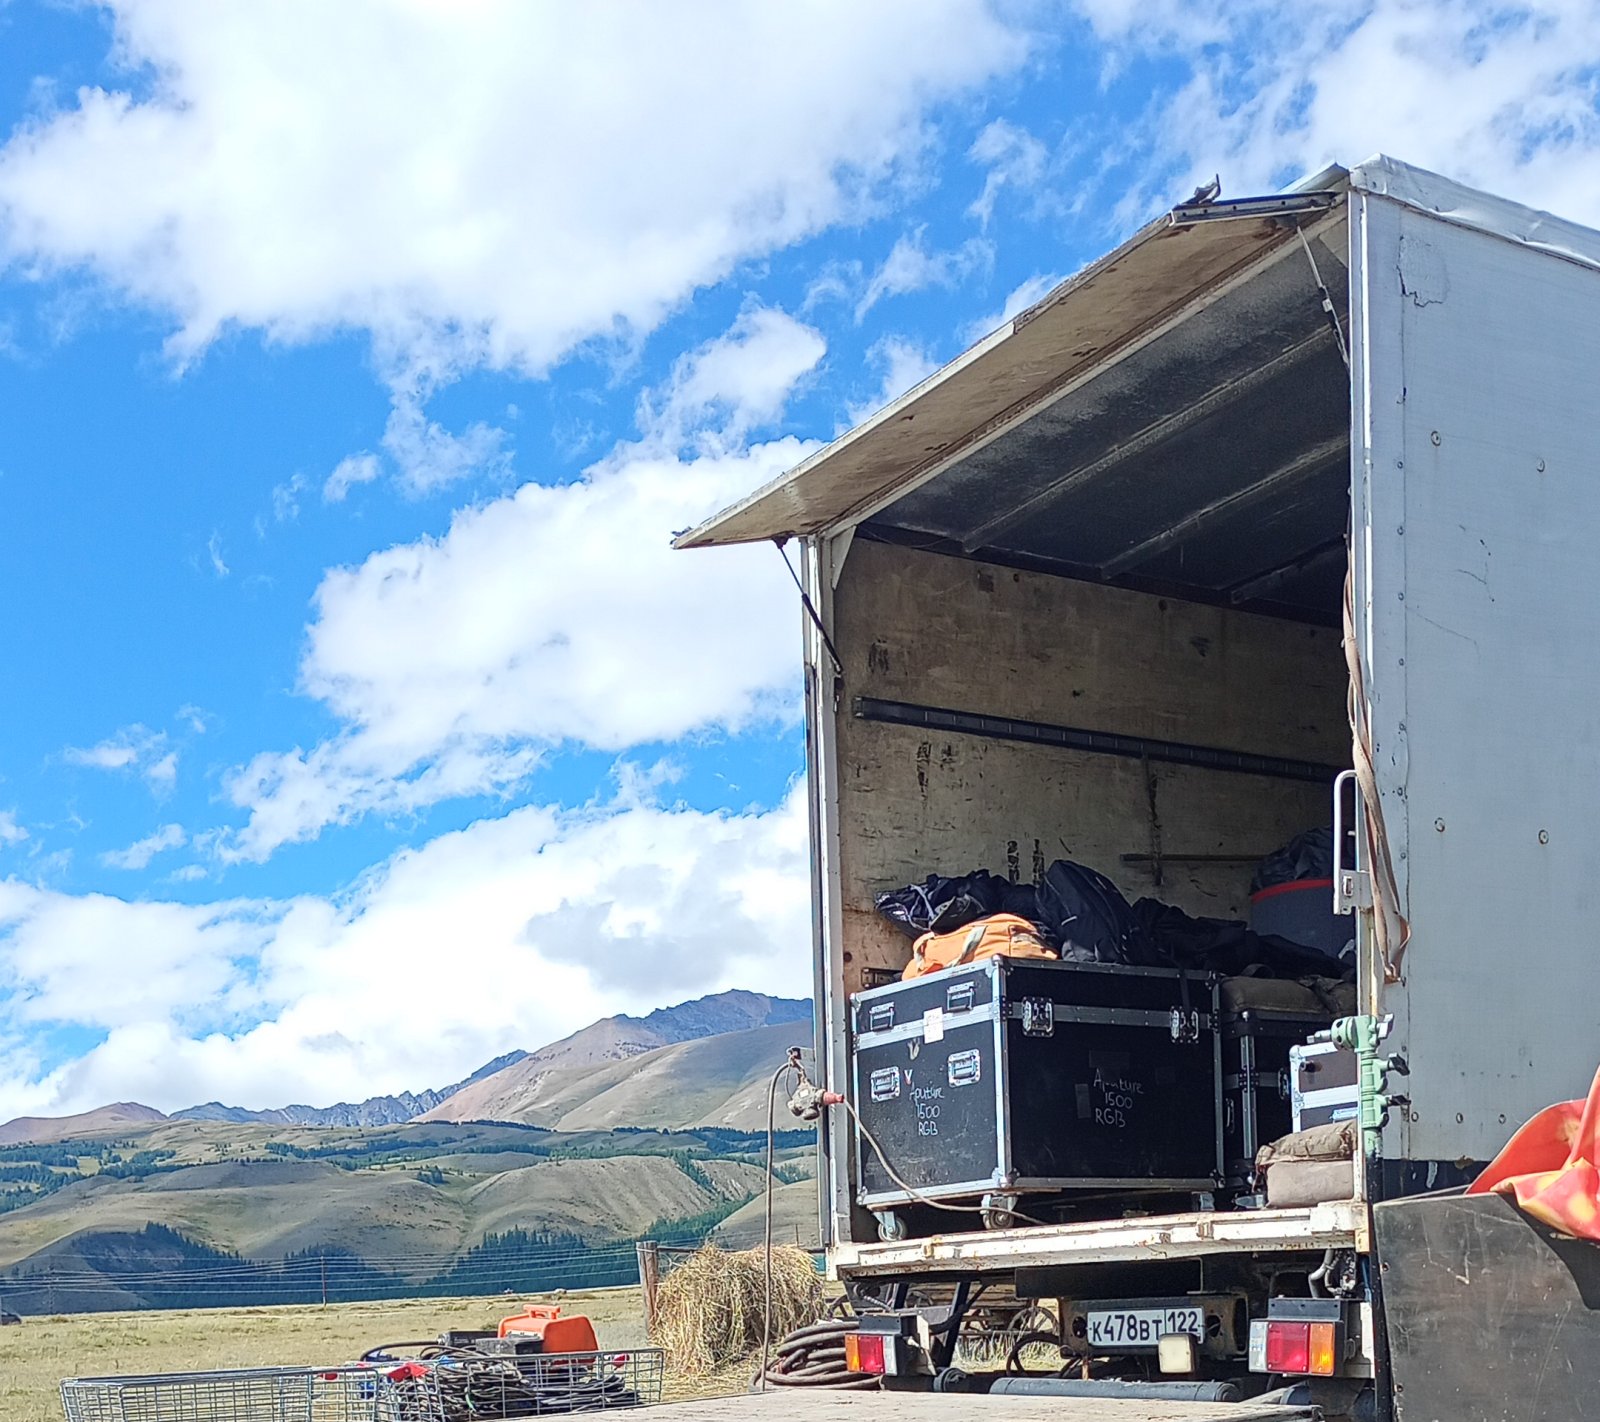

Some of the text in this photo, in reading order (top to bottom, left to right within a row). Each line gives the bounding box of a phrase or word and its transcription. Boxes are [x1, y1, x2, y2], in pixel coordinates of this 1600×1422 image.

[1105, 1091, 1133, 1109] 1500
[916, 1103, 940, 1119] 1500
[1095, 1107, 1126, 1128] RGB
[918, 1121, 939, 1136] RGB
